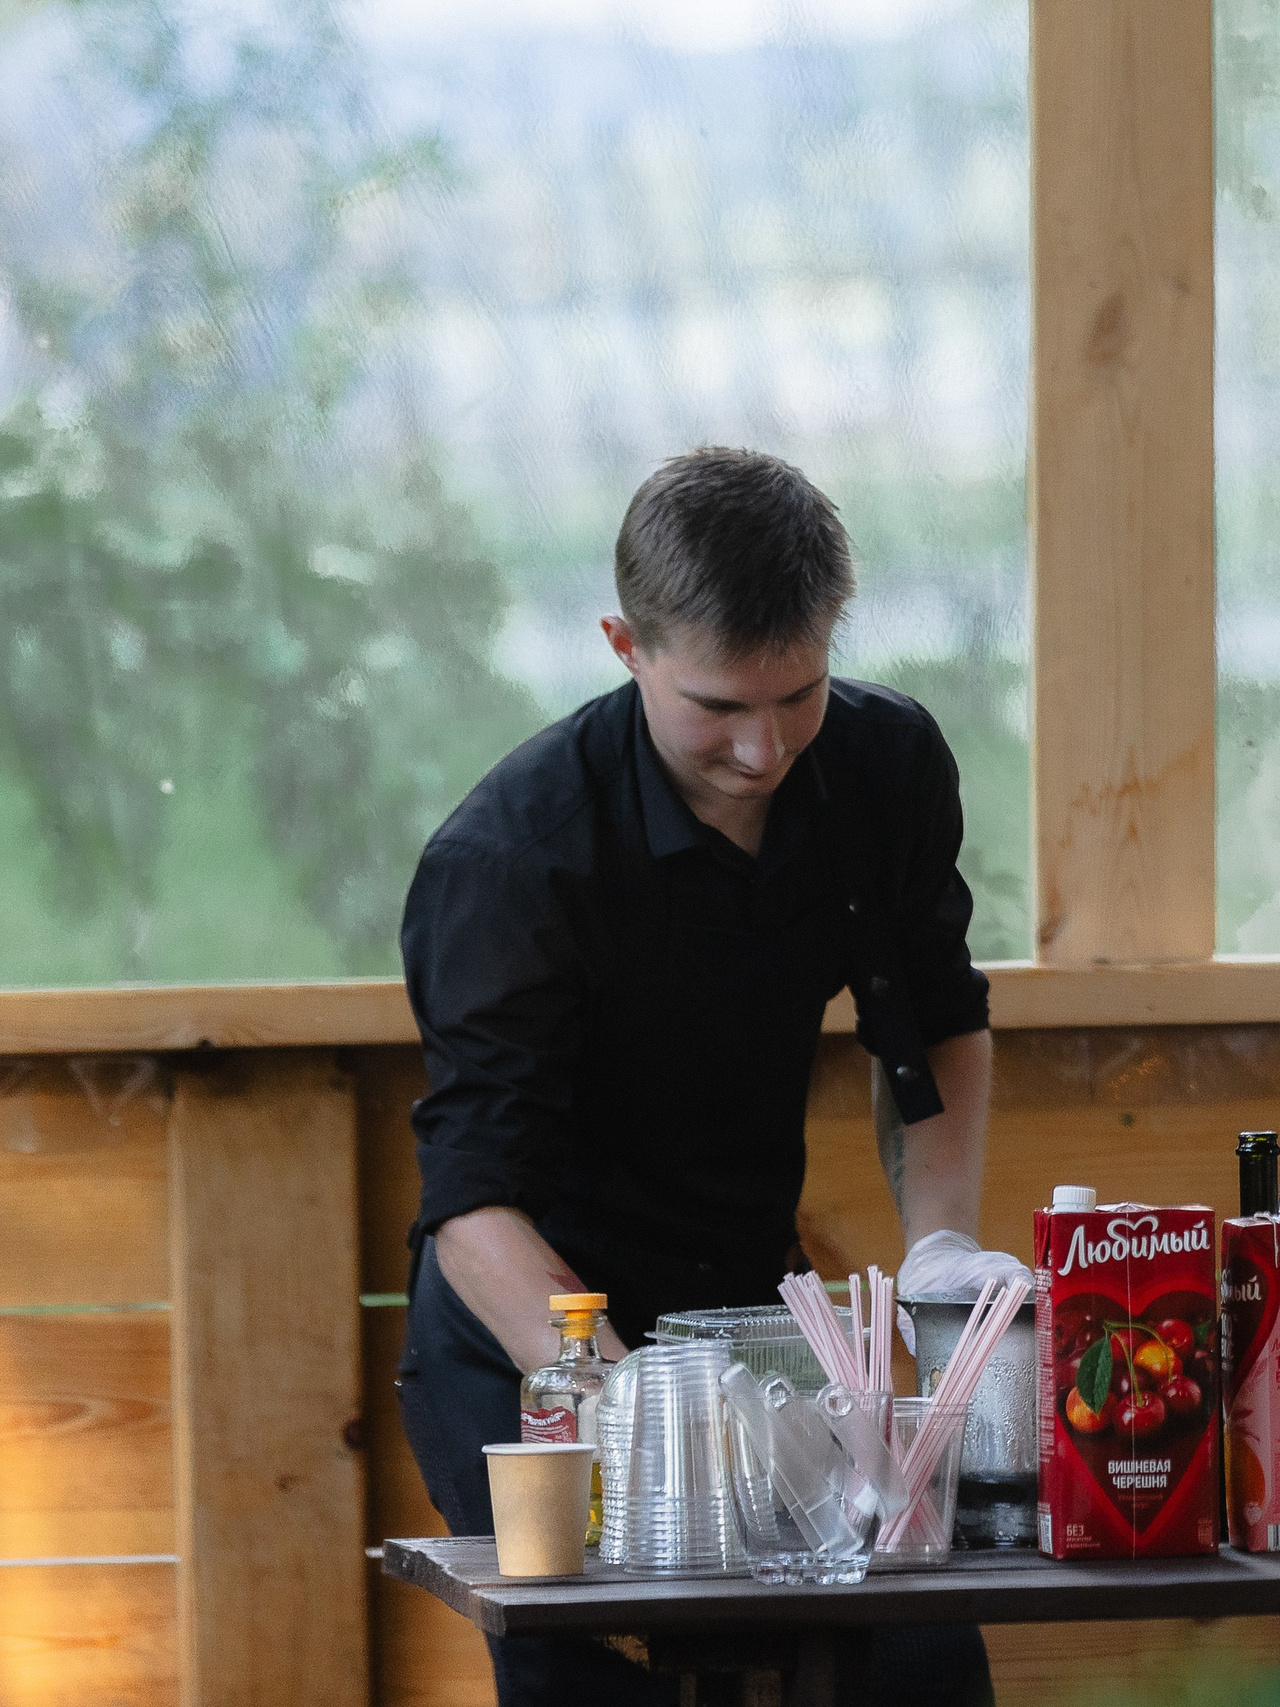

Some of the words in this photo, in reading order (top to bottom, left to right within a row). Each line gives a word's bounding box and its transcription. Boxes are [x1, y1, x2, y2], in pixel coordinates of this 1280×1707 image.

[1057, 1215, 1210, 1277] Любимый
[1108, 1458, 1171, 1474] ВИШНЕВАЯ
[1112, 1474, 1167, 1489] ЧЕРЕШНЯ
[1066, 1523, 1085, 1537] БЕЗ
